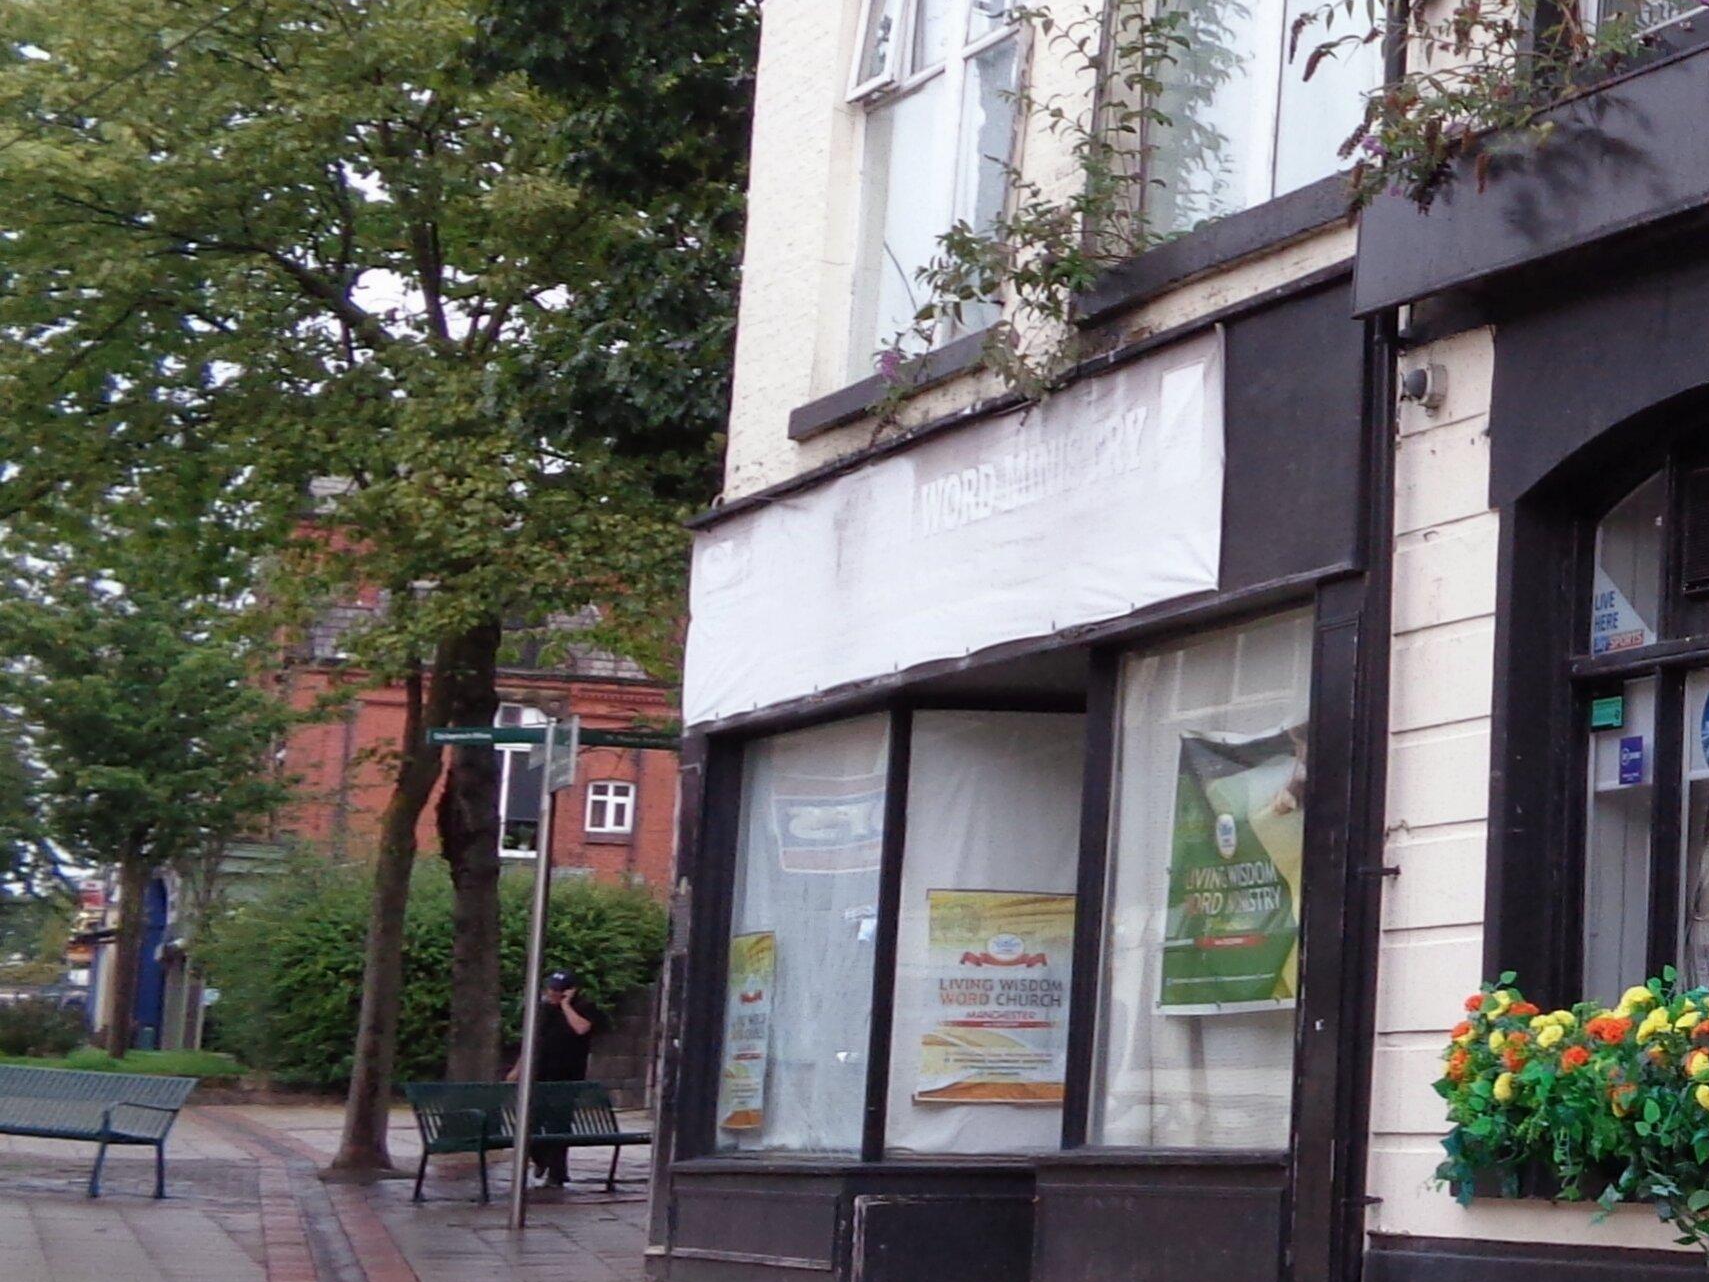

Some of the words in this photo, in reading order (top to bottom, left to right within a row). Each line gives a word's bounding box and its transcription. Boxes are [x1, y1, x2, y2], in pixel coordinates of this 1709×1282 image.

[1595, 590, 1615, 611] LIVE
[1595, 611, 1619, 632] HERE
[939, 978, 994, 992] LIVING
[999, 978, 1063, 993] WISDOM
[940, 992, 990, 1007] WORD
[996, 993, 1062, 1008] CHURCH
[965, 1010, 1037, 1020] MANCHESTER
